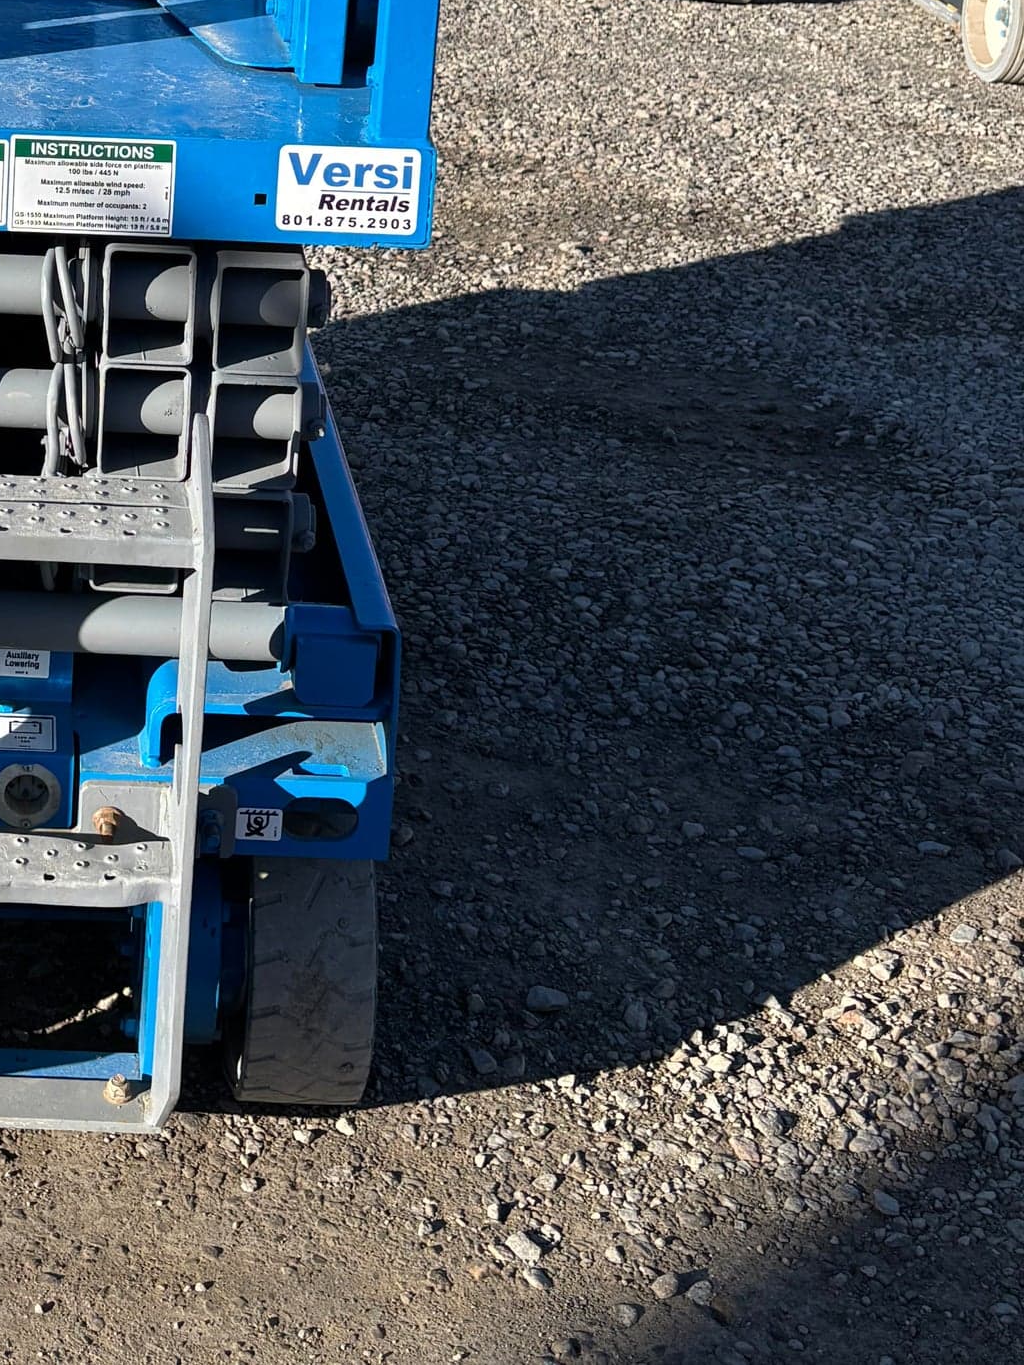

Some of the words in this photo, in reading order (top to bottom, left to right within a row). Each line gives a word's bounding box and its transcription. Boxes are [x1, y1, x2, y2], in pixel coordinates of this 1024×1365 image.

[30, 141, 155, 160] INSTRUCTIONS
[24, 158, 56, 166] Maximum
[134, 163, 163, 171] platform:
[288, 152, 414, 190] Versi
[40, 178, 72, 186] Maximum
[123, 182, 146, 190] speed:
[37, 199, 68, 207] Maximum
[318, 194, 410, 213] Rentals
[105, 215, 128, 223] Height:
[281, 214, 412, 230] 801.875.2903
[6, 650, 39, 662] Auxiliary
[5, 659, 40, 670] Lowering
